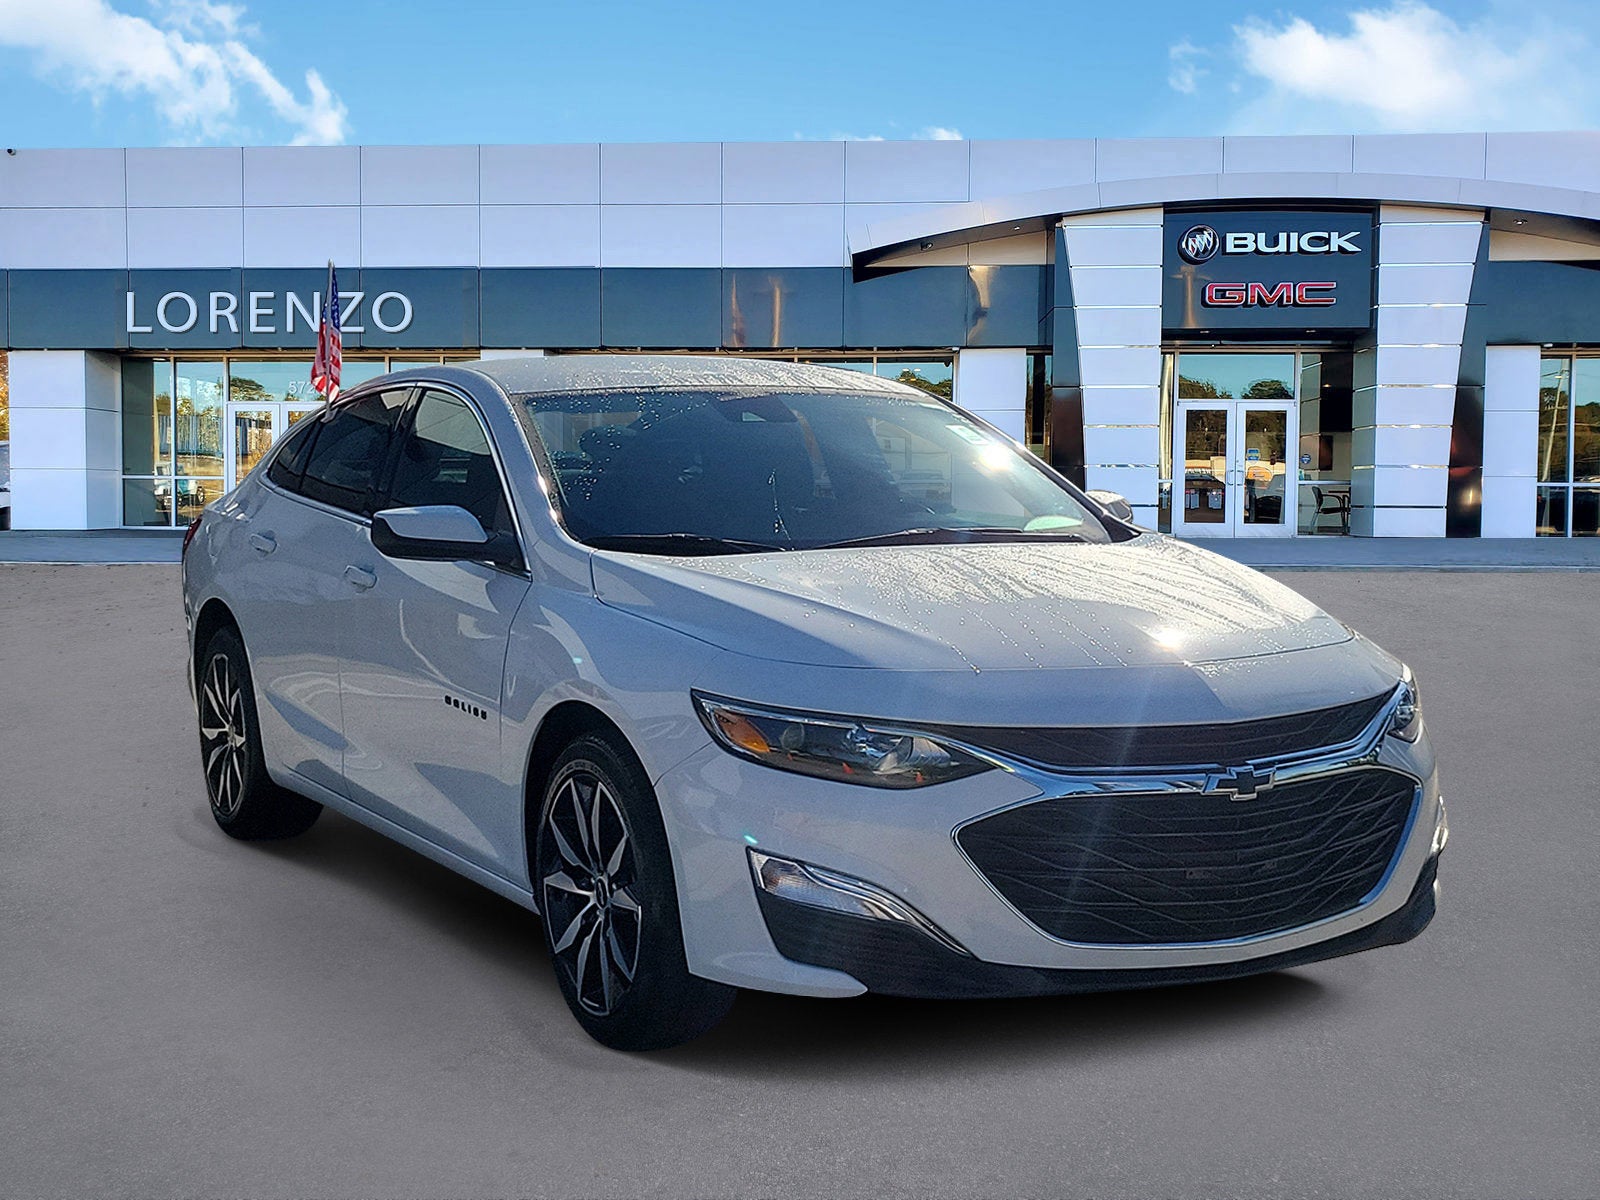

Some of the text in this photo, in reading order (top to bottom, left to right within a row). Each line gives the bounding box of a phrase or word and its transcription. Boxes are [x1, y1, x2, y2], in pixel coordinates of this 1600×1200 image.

[1226, 231, 1362, 253] BUICK
[1205, 281, 1337, 305] GMC
[126, 290, 413, 334] LORENZO
